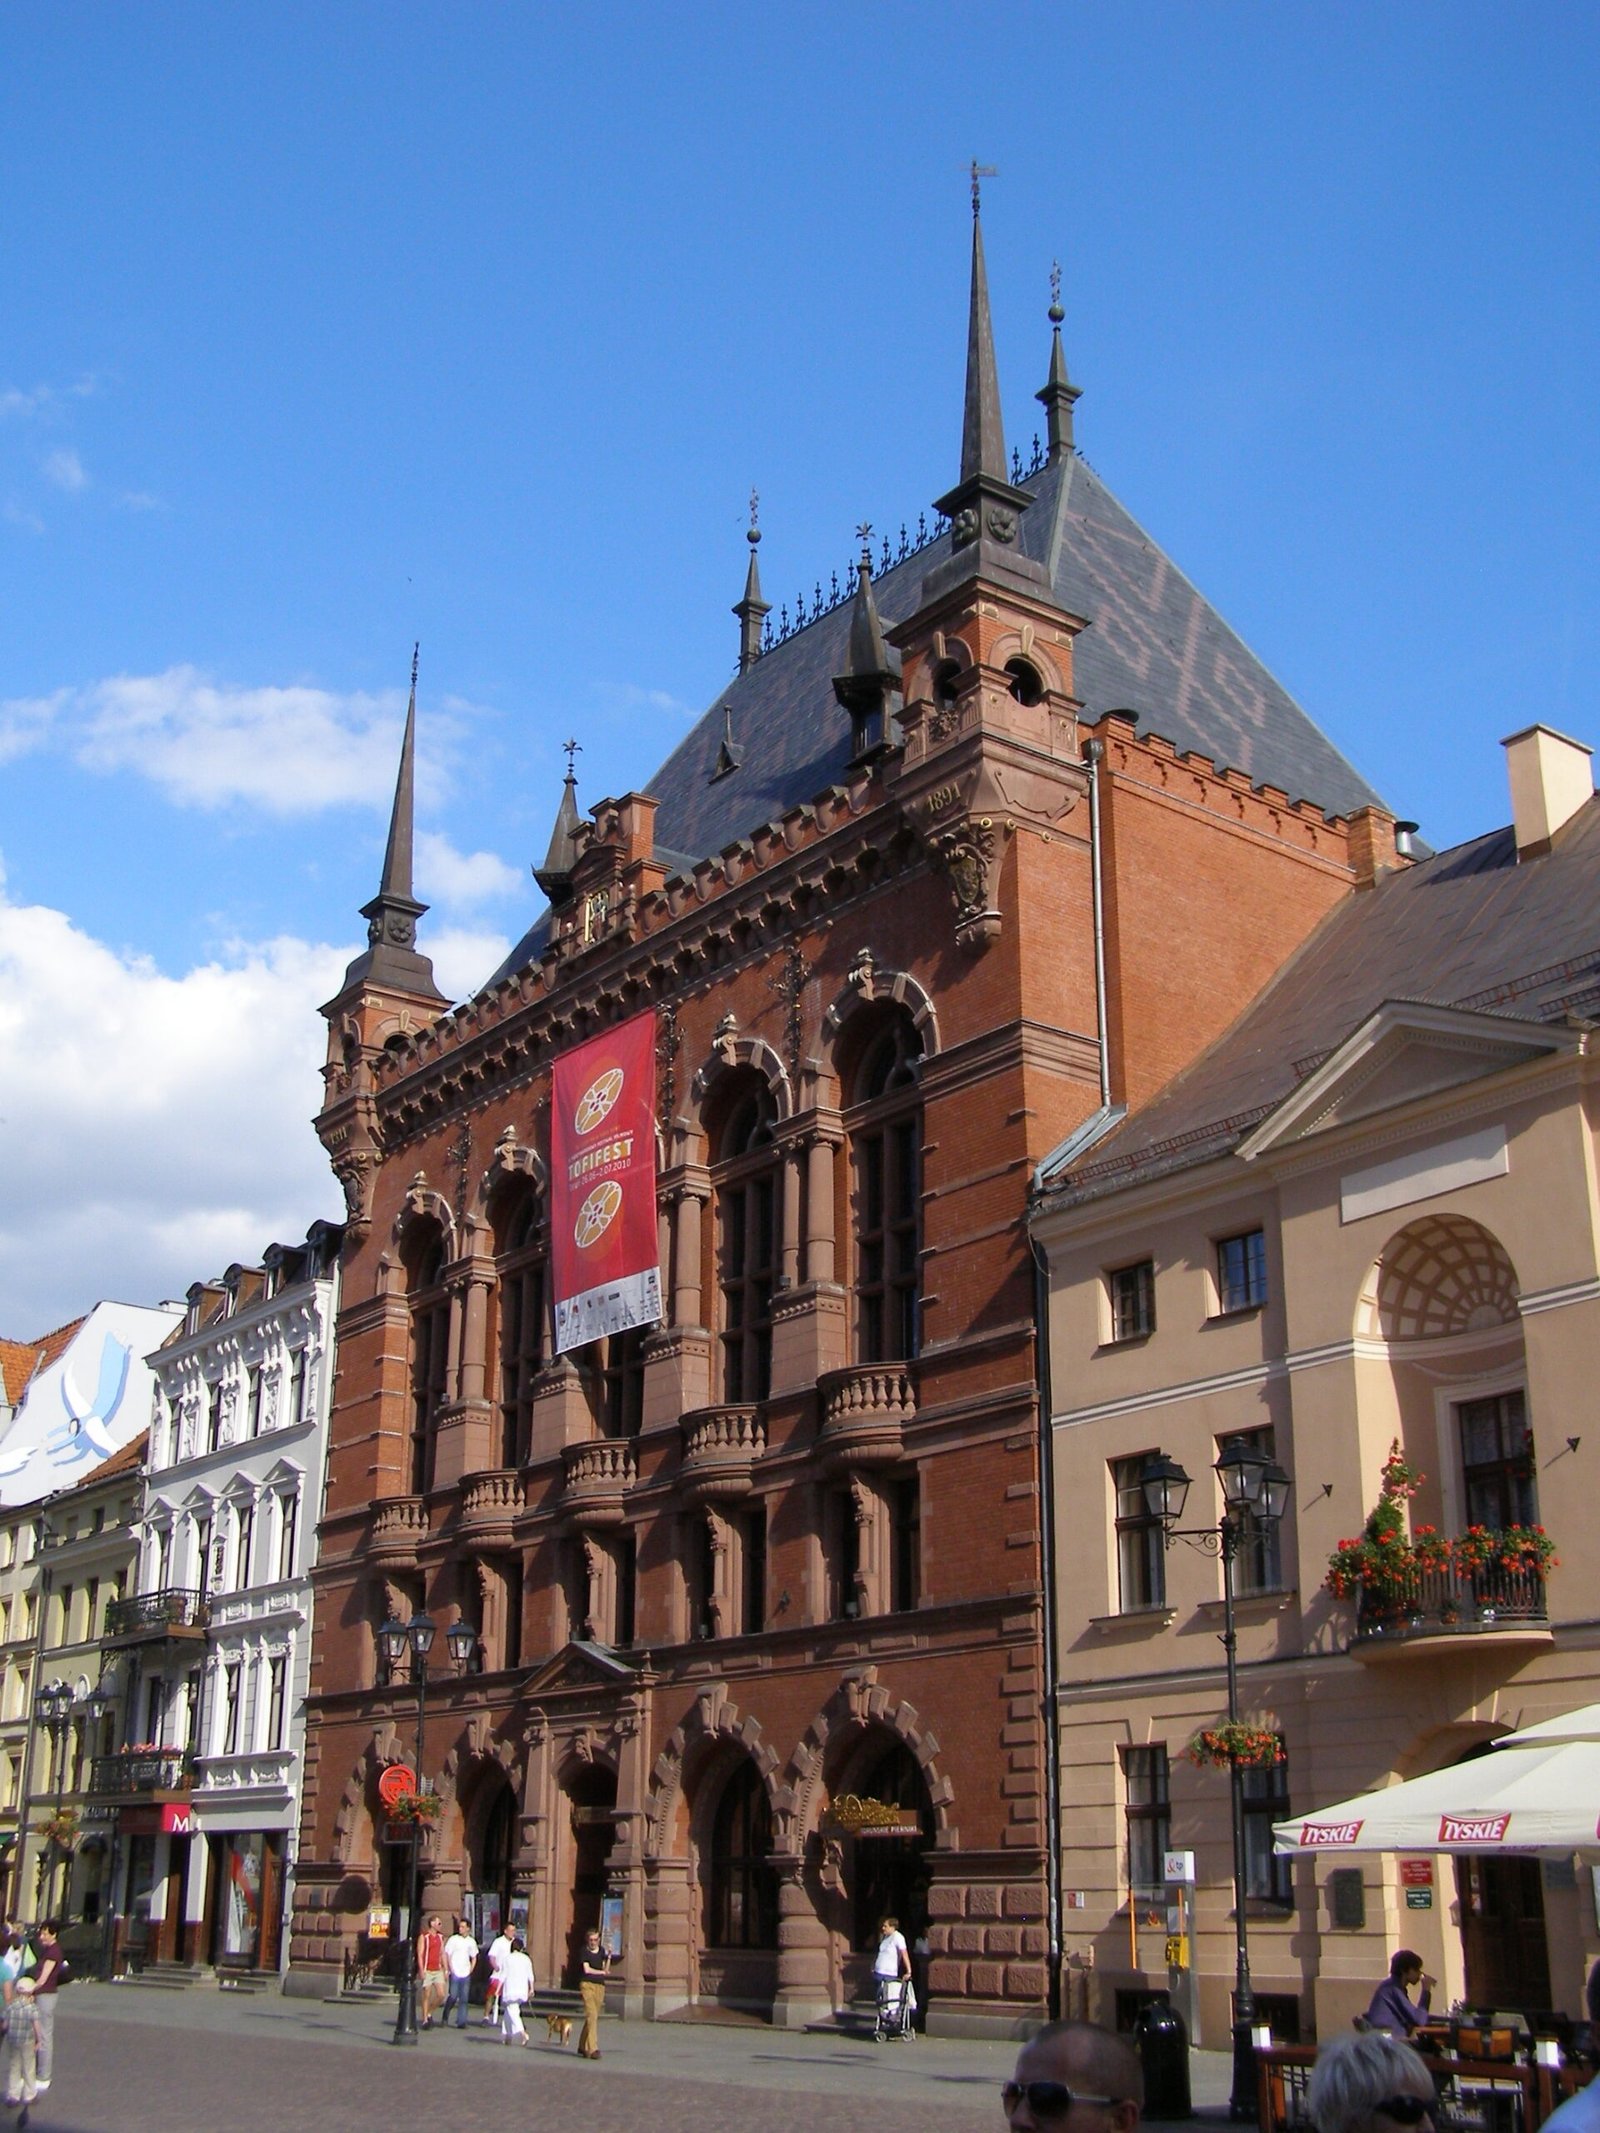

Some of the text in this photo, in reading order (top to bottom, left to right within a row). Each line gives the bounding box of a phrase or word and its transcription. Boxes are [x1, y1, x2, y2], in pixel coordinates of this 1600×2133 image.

[927, 781, 961, 814] 1891
[568, 1137, 634, 1181] TOFIFEST
[1304, 1823, 1358, 1843] TYSKIE
[1444, 1818, 1504, 1840] TYSKIE
